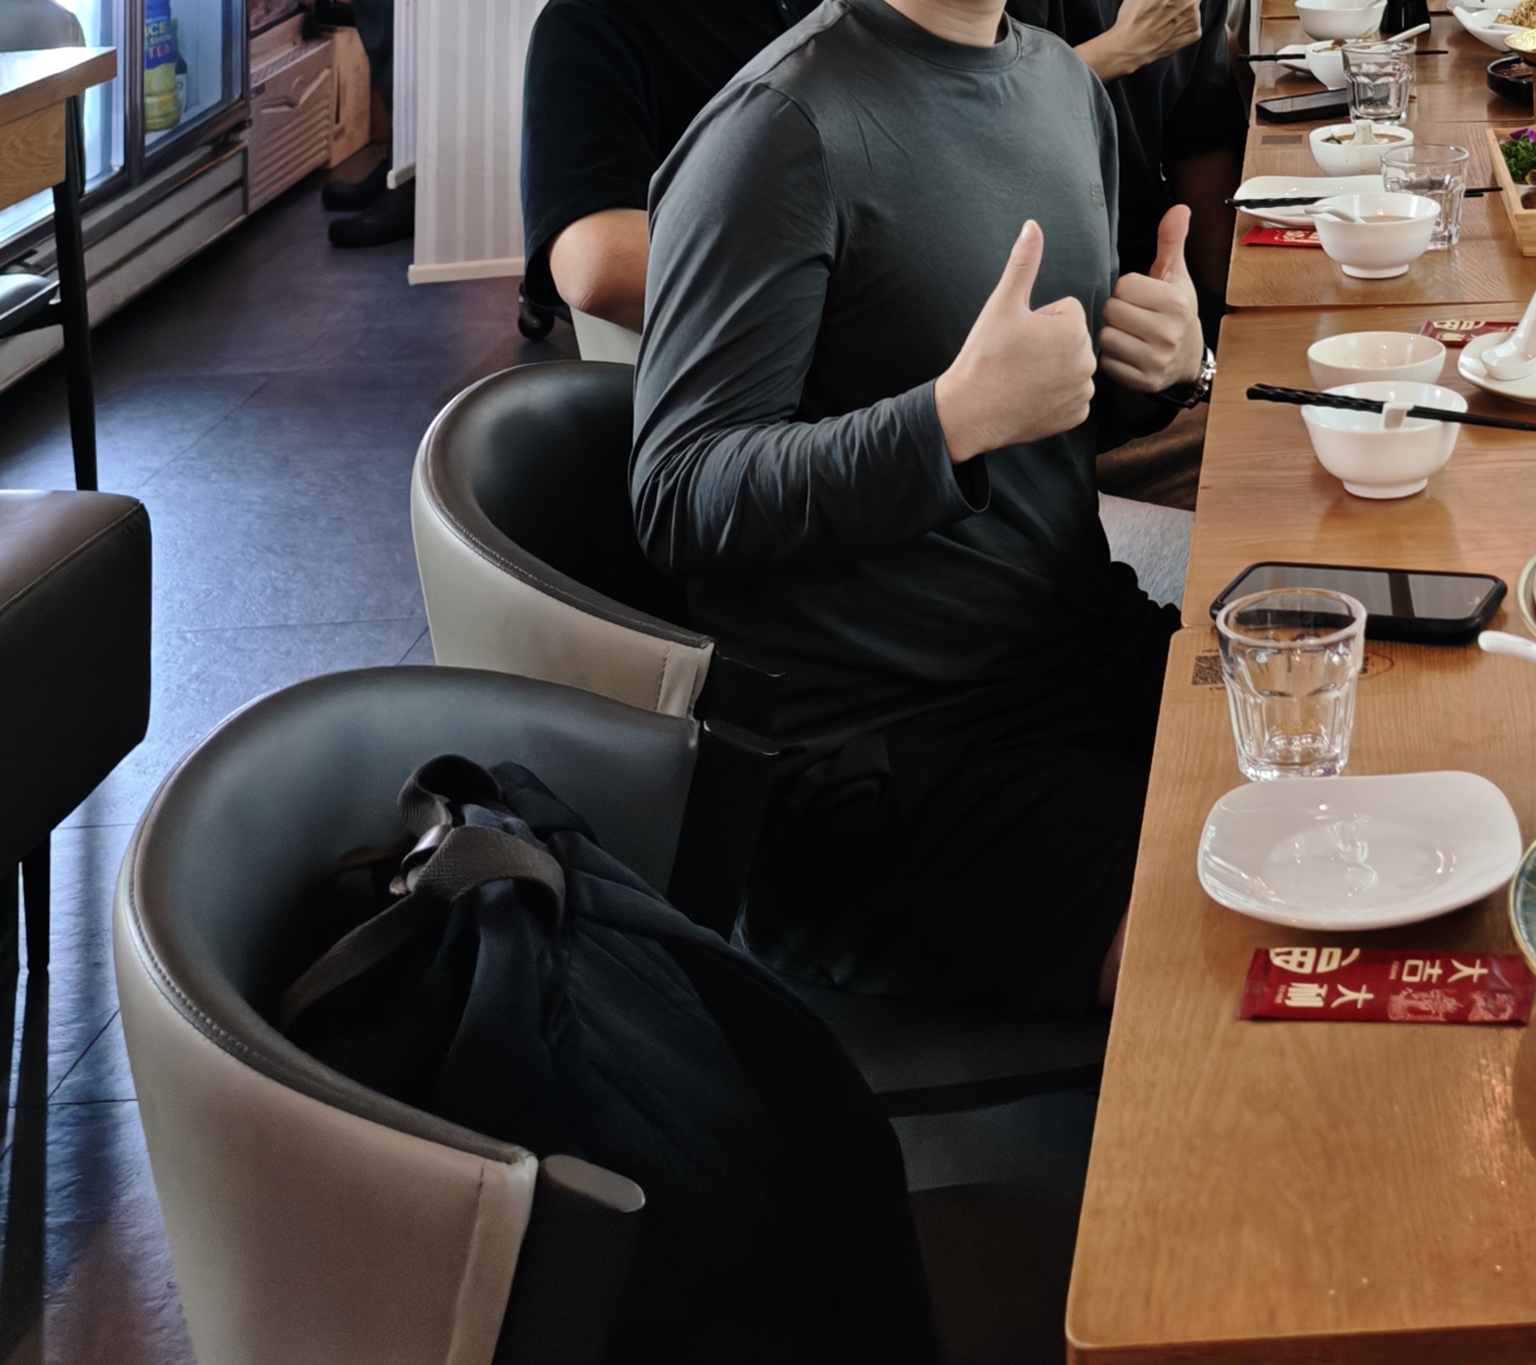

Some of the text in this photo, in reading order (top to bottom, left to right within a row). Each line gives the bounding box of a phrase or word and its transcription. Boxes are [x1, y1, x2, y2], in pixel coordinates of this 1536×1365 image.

[148, 43, 171, 60] TEA
[1401, 957, 1489, 984] 大吉
[1283, 982, 1376, 1009] 大利
